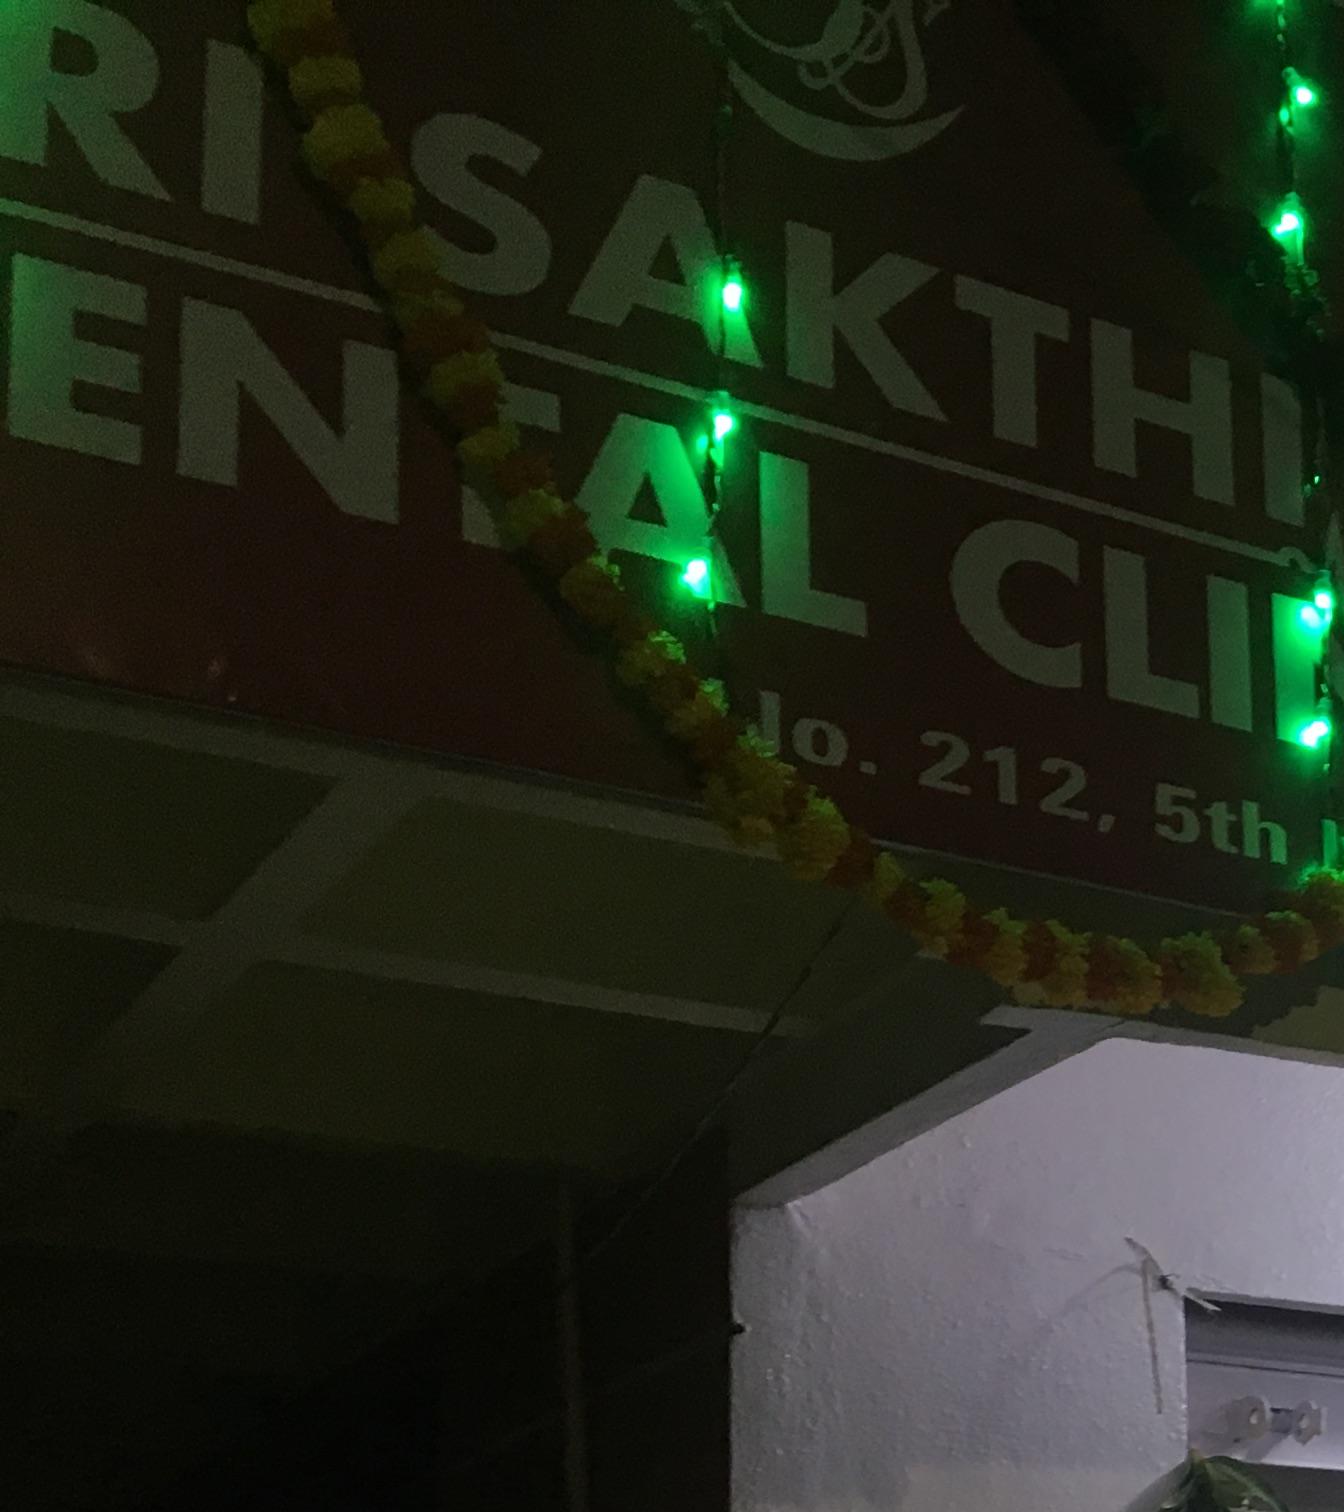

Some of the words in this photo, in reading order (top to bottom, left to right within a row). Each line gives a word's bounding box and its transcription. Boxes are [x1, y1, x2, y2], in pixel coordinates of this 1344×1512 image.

[409, 112, 1306, 528] SAKTHI
[918, 729, 1117, 833] 212,
[1154, 781, 1289, 866] 5th
